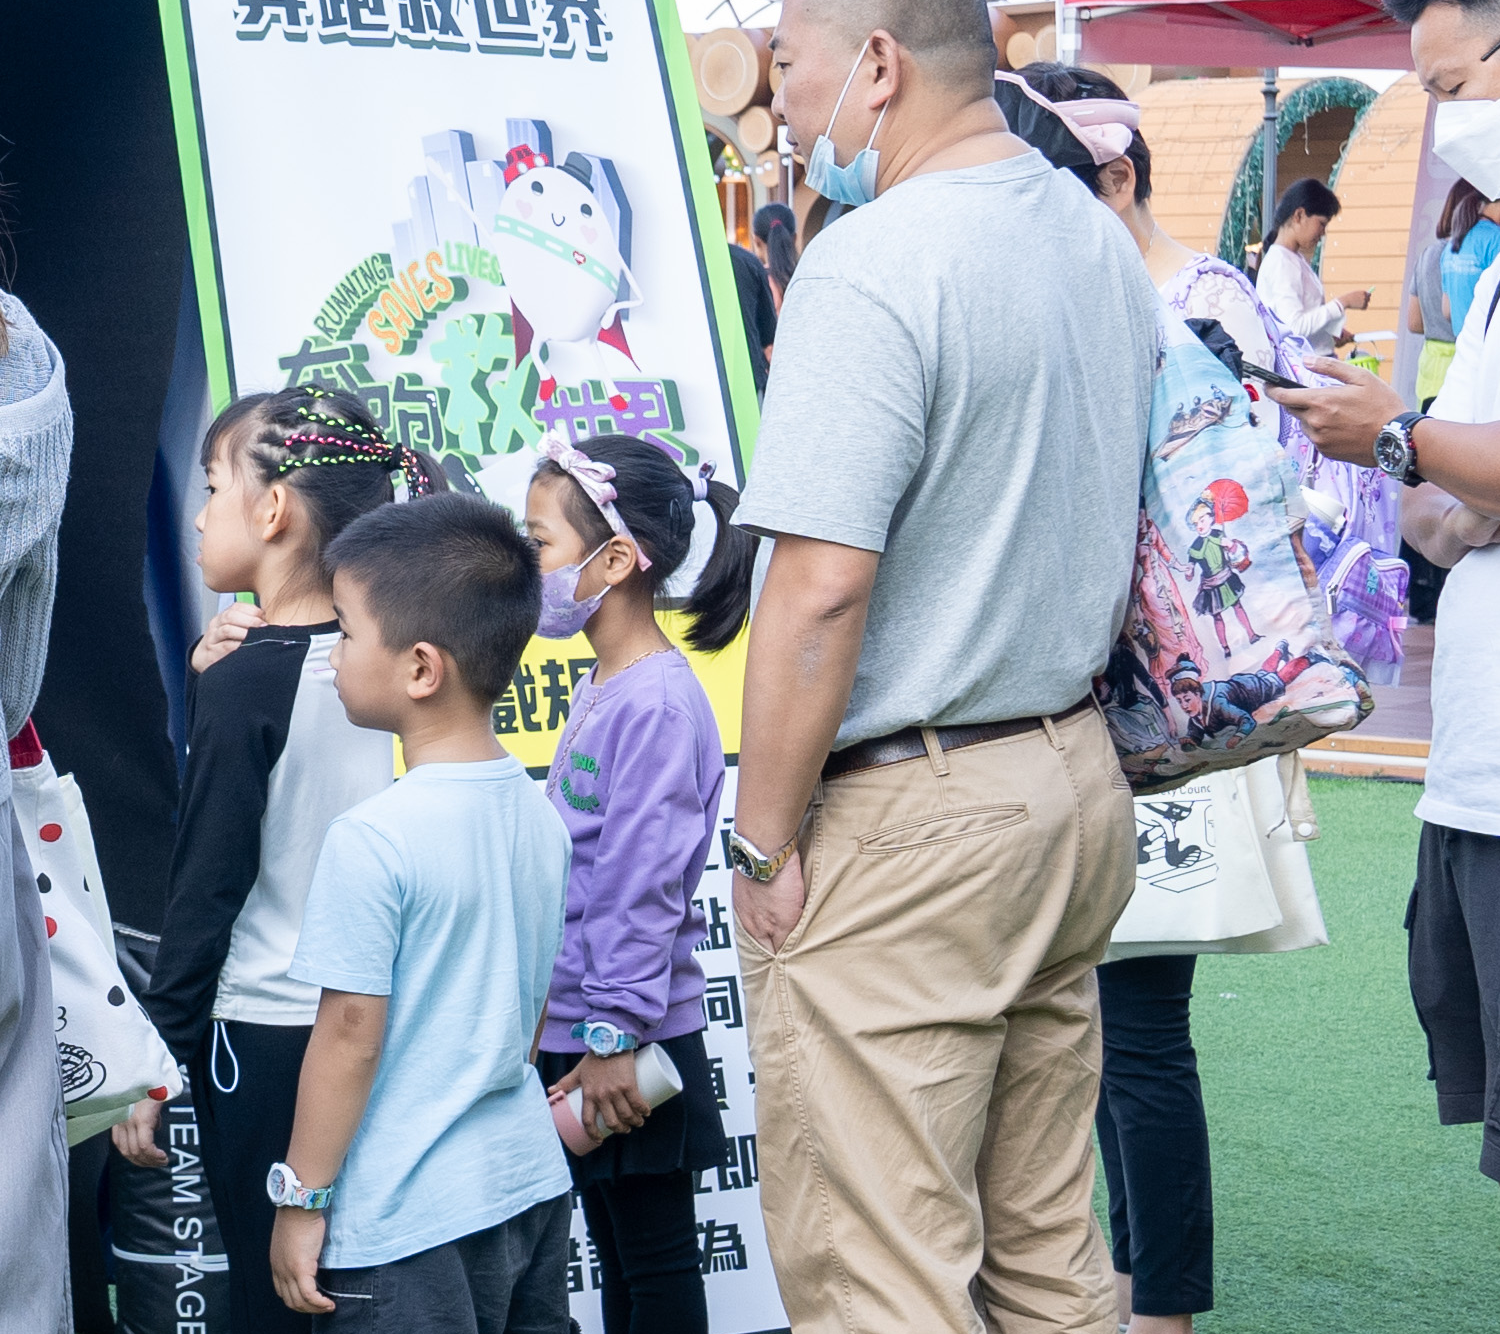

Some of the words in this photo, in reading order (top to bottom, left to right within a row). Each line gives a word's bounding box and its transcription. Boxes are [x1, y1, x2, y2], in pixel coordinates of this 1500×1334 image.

[313, 253, 391, 340] RUNNING
[367, 251, 454, 355] SAVES
[444, 240, 502, 285] LIVES
[168, 1104, 202, 1203] TEAM
